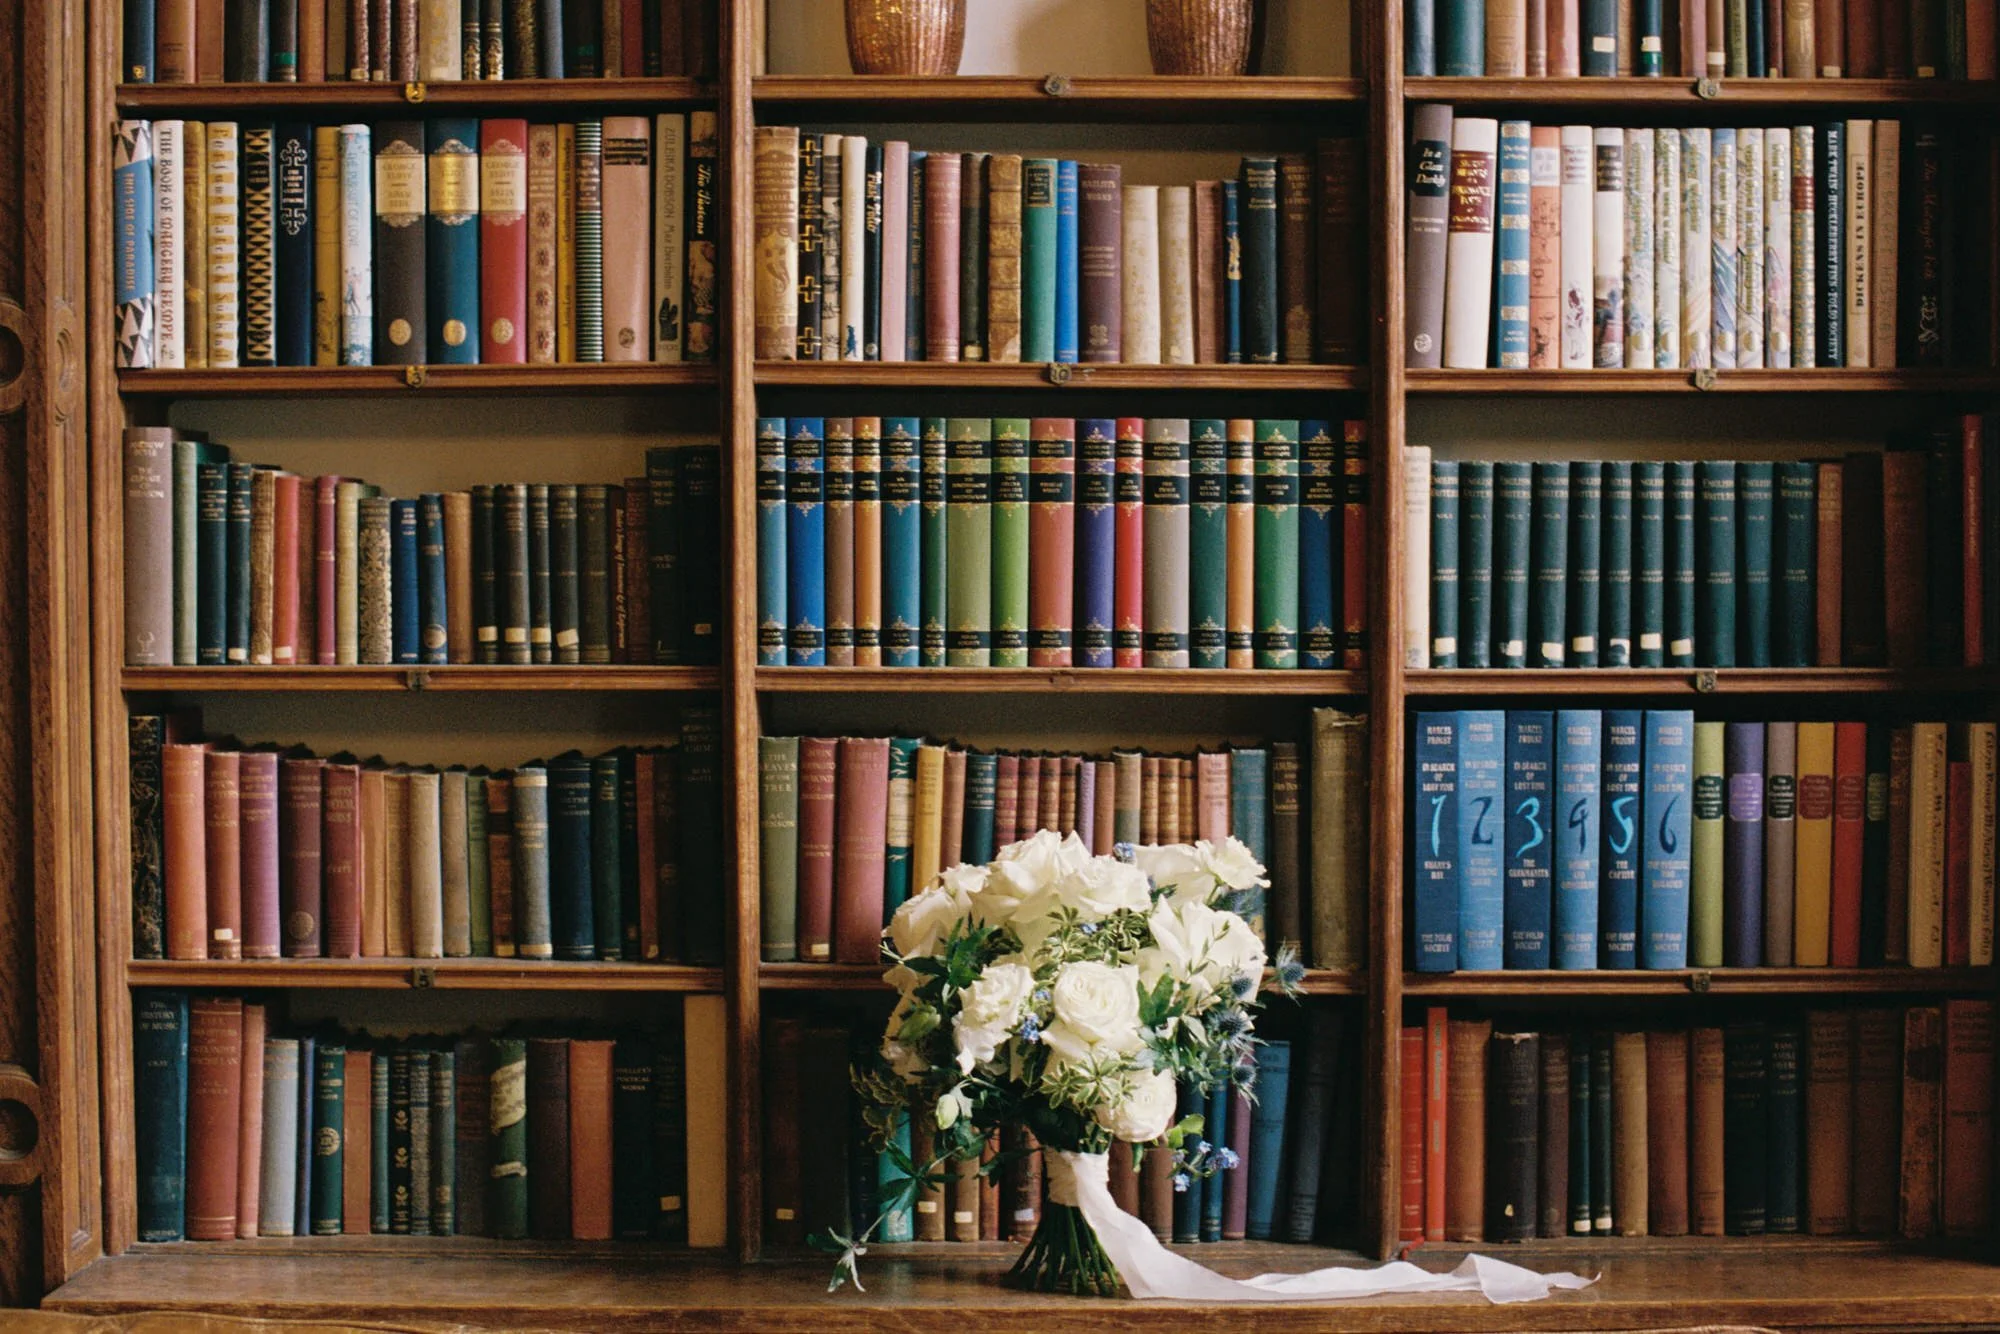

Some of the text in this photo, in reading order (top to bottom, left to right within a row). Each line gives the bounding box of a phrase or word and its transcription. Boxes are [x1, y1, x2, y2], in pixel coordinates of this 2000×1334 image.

[211, 129, 229, 204] Perfume
[697, 164, 712, 187] The
[124, 173, 137, 290] THIS SIDE OF PARADISE
[157, 128, 174, 341] THE BOOK OF MARGERY KEMPE
[213, 215, 229, 284] Patrick
[1828, 130, 1838, 359] MARK TWAIN HUCKLEBERRY FINN FOLIO SOCIETY
[1856, 162, 1865, 307] DICKENS IN EUROPE
[1432, 794, 1447, 858] 1
[1470, 796, 1494, 845] 2
[1515, 796, 1544, 859] 3
[1608, 796, 1635, 855] 5
[1659, 795, 1681, 855] 6
